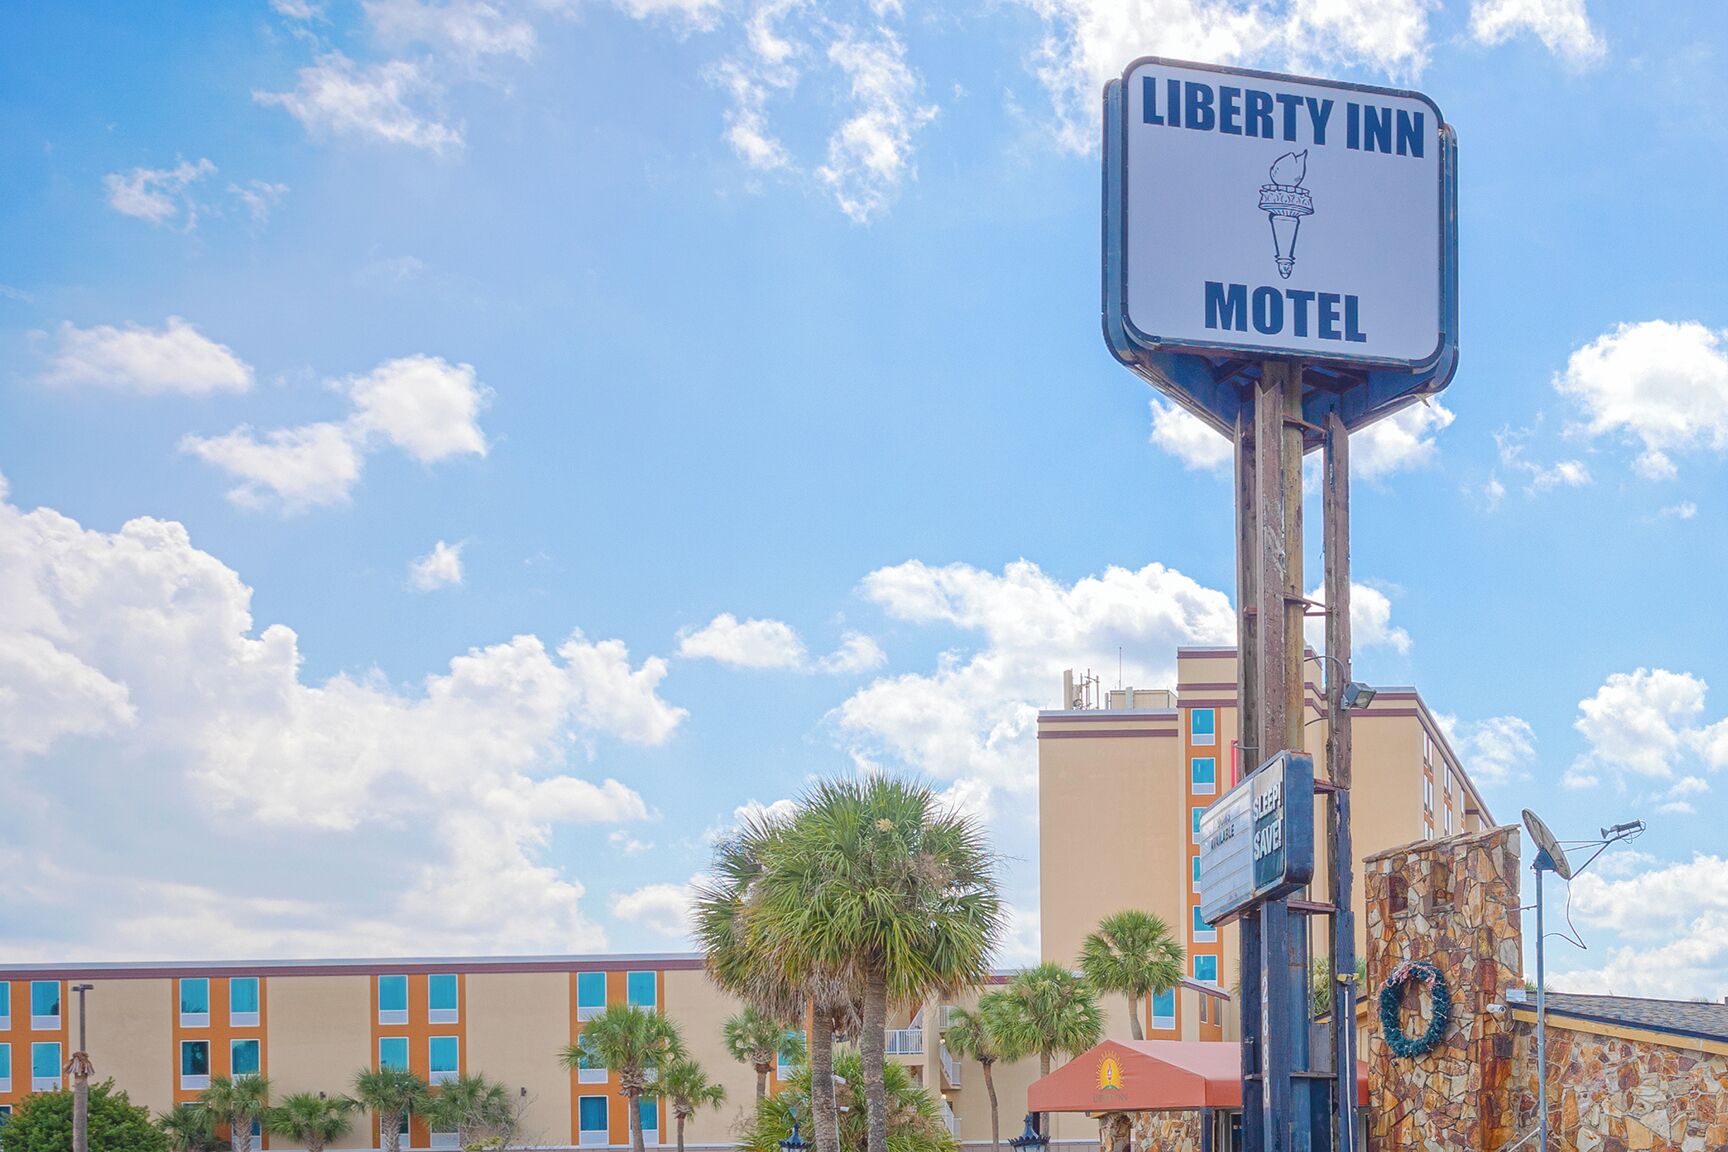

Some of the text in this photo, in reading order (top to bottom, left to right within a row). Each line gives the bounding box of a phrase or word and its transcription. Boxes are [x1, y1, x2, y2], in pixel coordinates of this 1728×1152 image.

[1143, 76, 1424, 158] LIBERTY INN
[1204, 281, 1367, 343] MOTEL
[1253, 781, 1282, 822] SLEEP!
[1254, 819, 1282, 861] SAVE!
[1262, 976, 1270, 1104] 2880
